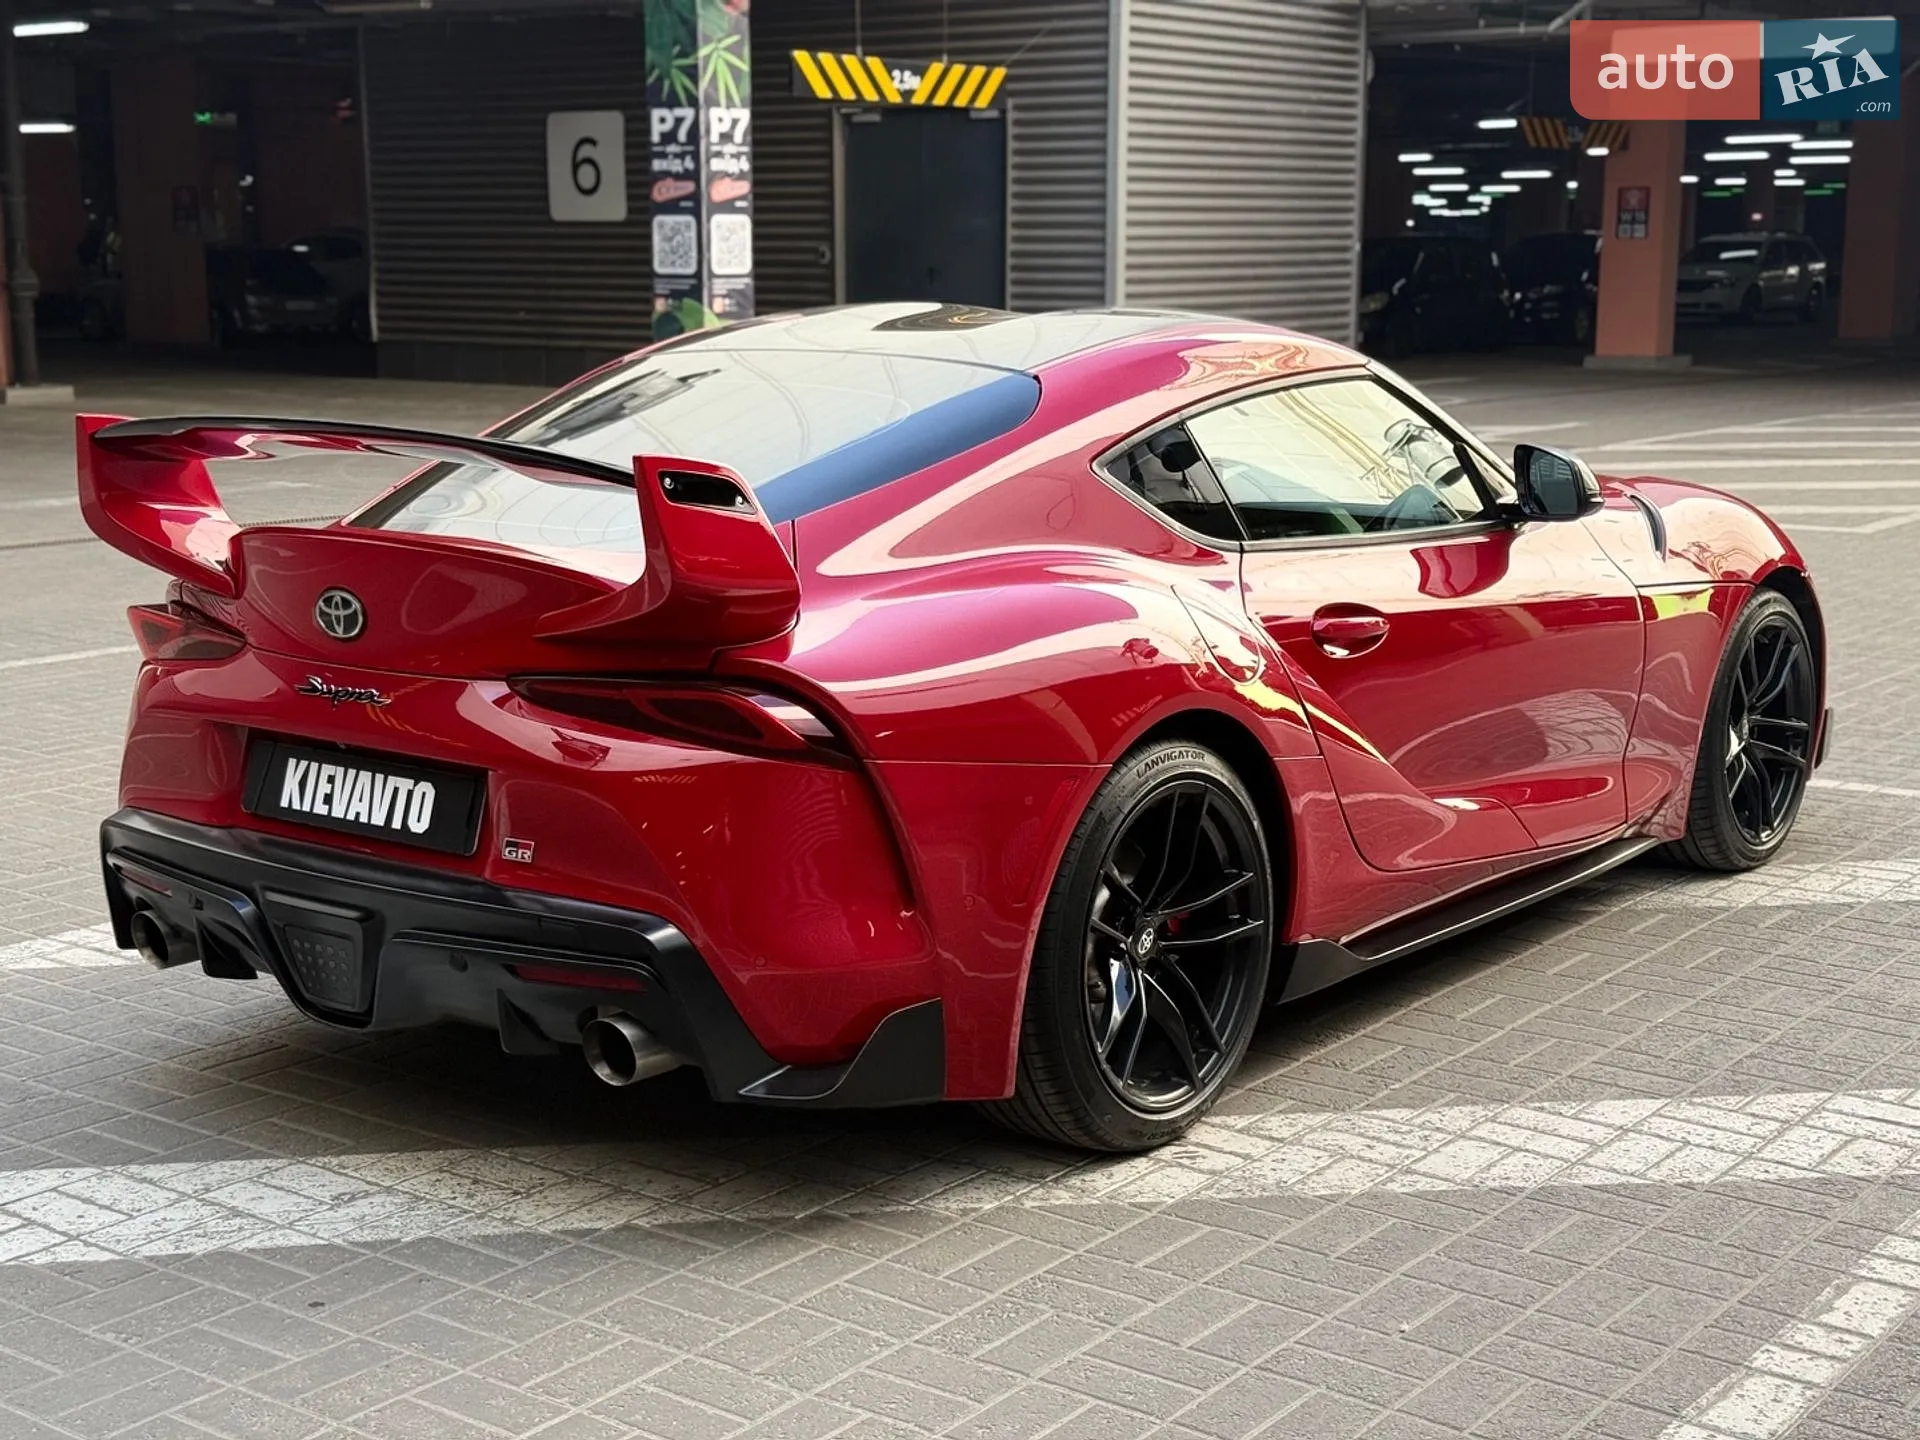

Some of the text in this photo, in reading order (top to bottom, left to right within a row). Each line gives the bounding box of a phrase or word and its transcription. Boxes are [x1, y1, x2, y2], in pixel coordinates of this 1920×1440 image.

[650, 107, 696, 144] P7
[708, 107, 751, 144] P7
[571, 136, 601, 197] 6
[294, 674, 392, 710] Supra
[1135, 750, 1206, 779] LANVIGATOR
[279, 757, 436, 834] KIEVAVTO
[505, 846, 532, 863] GR
